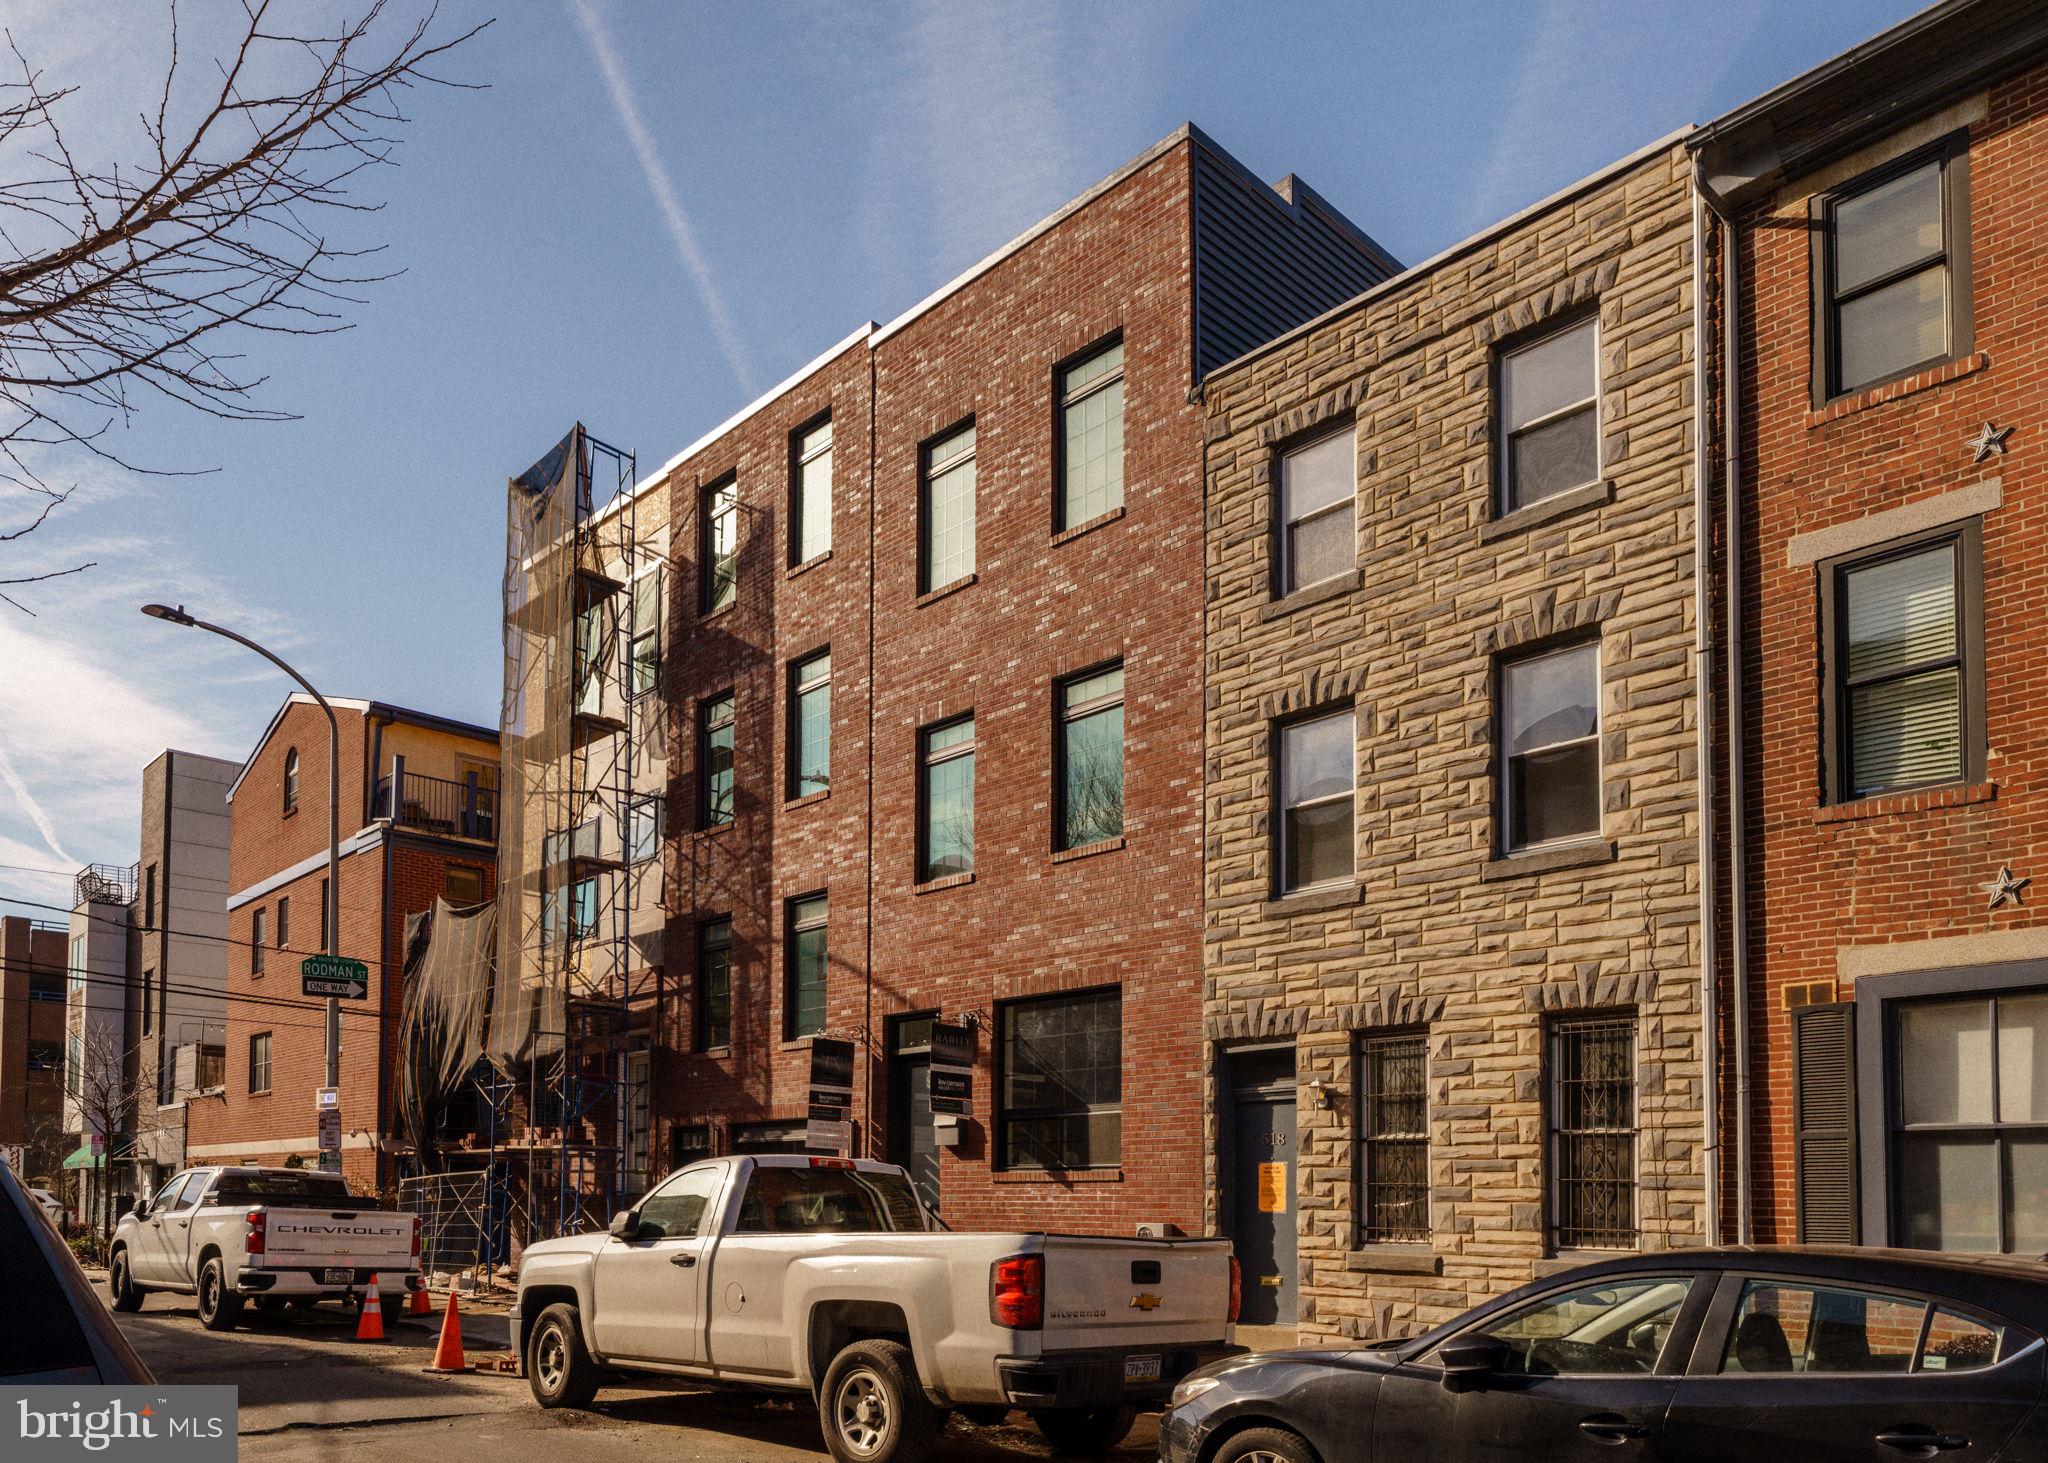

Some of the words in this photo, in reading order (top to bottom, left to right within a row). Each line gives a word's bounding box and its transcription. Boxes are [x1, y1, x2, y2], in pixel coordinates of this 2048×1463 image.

[304, 962, 353, 978] RODMAN
[357, 970, 367, 979] ST
[310, 982, 328, 991] ONE
[330, 983, 349, 993] WAY
[277, 1225, 405, 1236] CHEVROLET
[1050, 1309, 1106, 1319] SILVERADO
